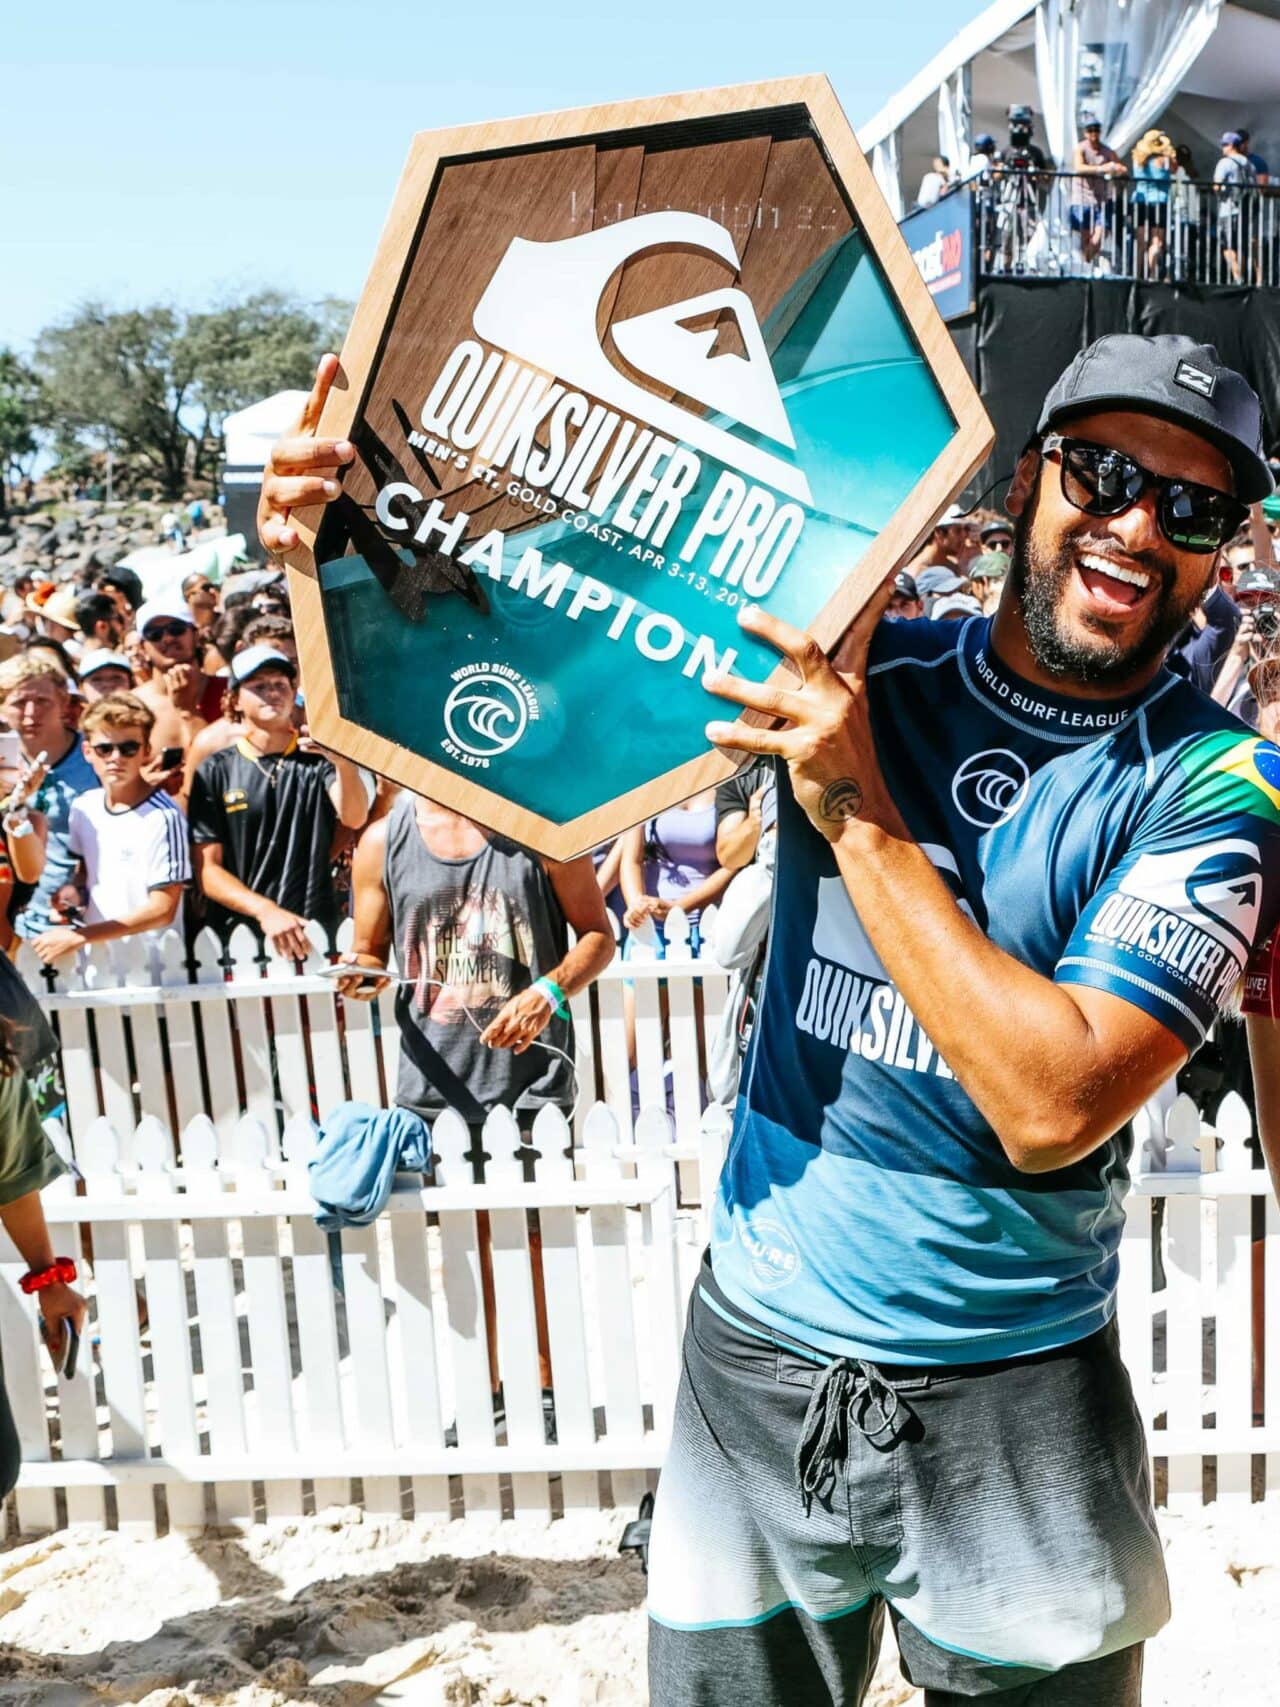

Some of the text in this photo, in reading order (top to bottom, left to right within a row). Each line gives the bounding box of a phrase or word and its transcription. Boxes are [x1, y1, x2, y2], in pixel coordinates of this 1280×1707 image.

[407, 430, 470, 470] MEN'S
[507, 481, 557, 514] GOLD
[561, 507, 625, 552] COAST,
[628, 543, 666, 571] APR
[668, 563, 711, 596] 3-13,
[421, 339, 806, 598] QUIKSILVER PRO
[375, 481, 739, 679] CHAMPION
[450, 662, 540, 721] WORLD SURF LEAGUE
[974, 648, 1129, 727] WORLD SURF LEAGUE
[440, 738, 459, 760] EST.
[1090, 893, 1226, 991] QUIKSILVER
[1137, 951, 1165, 969] GOLD
[795, 958, 959, 1082] QUIKSILV
